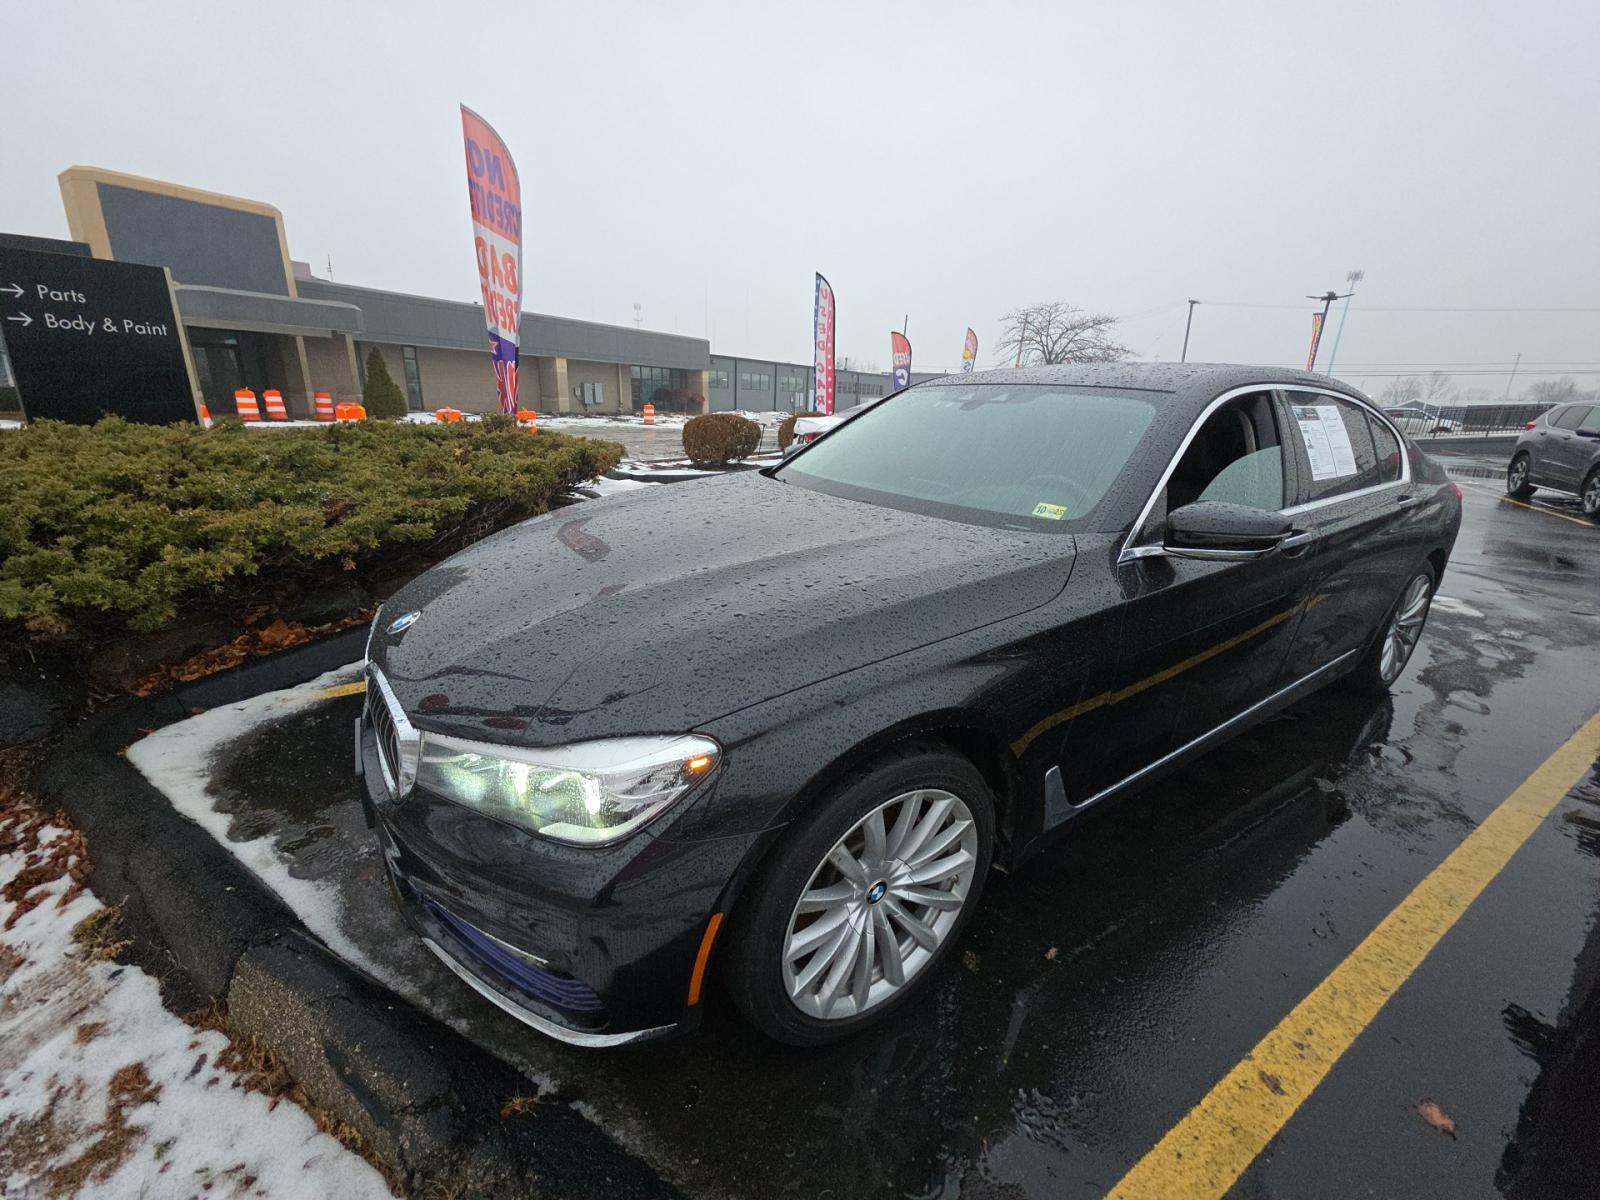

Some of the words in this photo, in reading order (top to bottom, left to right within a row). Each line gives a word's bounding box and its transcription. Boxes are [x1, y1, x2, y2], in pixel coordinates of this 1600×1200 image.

[36, 284, 87, 304] Parts
[44, 313, 96, 336] Body
[103, 317, 119, 333] &
[123, 319, 168, 336] Paint
